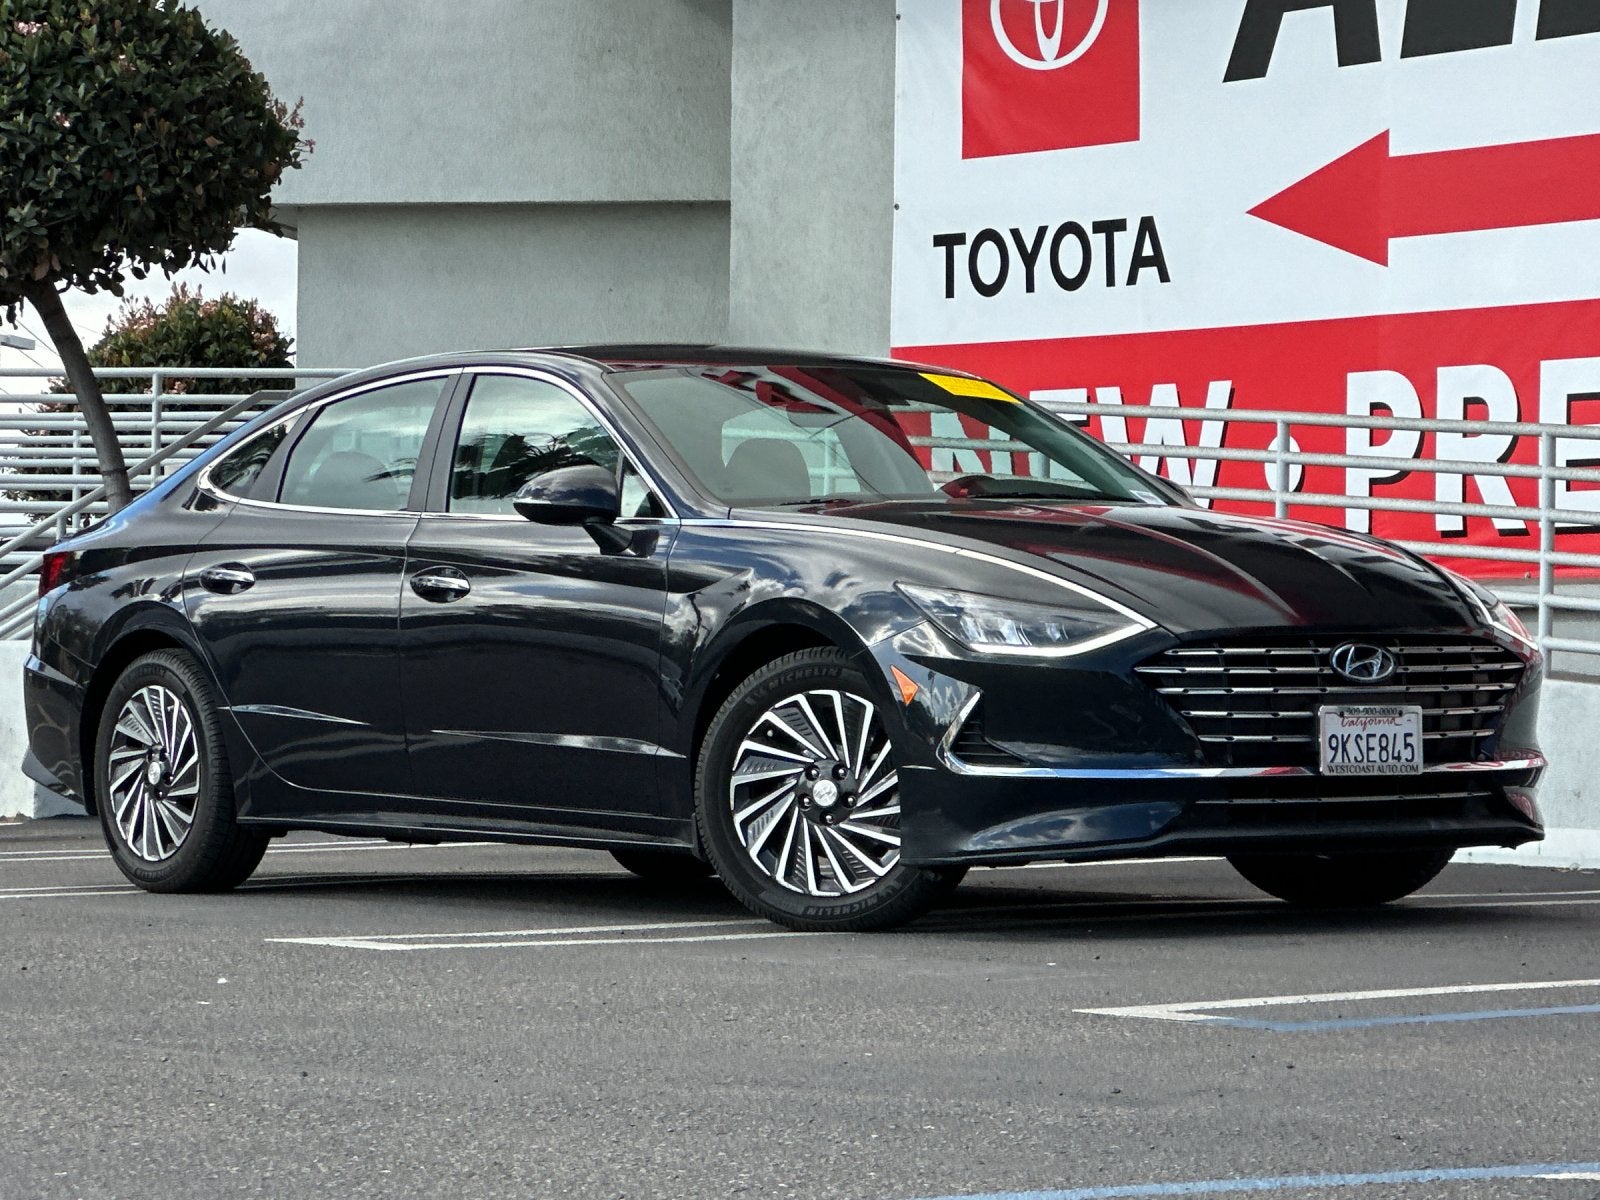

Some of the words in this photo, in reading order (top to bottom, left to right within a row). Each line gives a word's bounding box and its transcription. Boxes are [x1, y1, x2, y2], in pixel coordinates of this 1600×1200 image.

[933, 216, 1170, 298] TOYOTA
[768, 667, 842, 690] MICHELIN
[1341, 717, 1403, 732] California
[1328, 733, 1416, 764] 9KSE845
